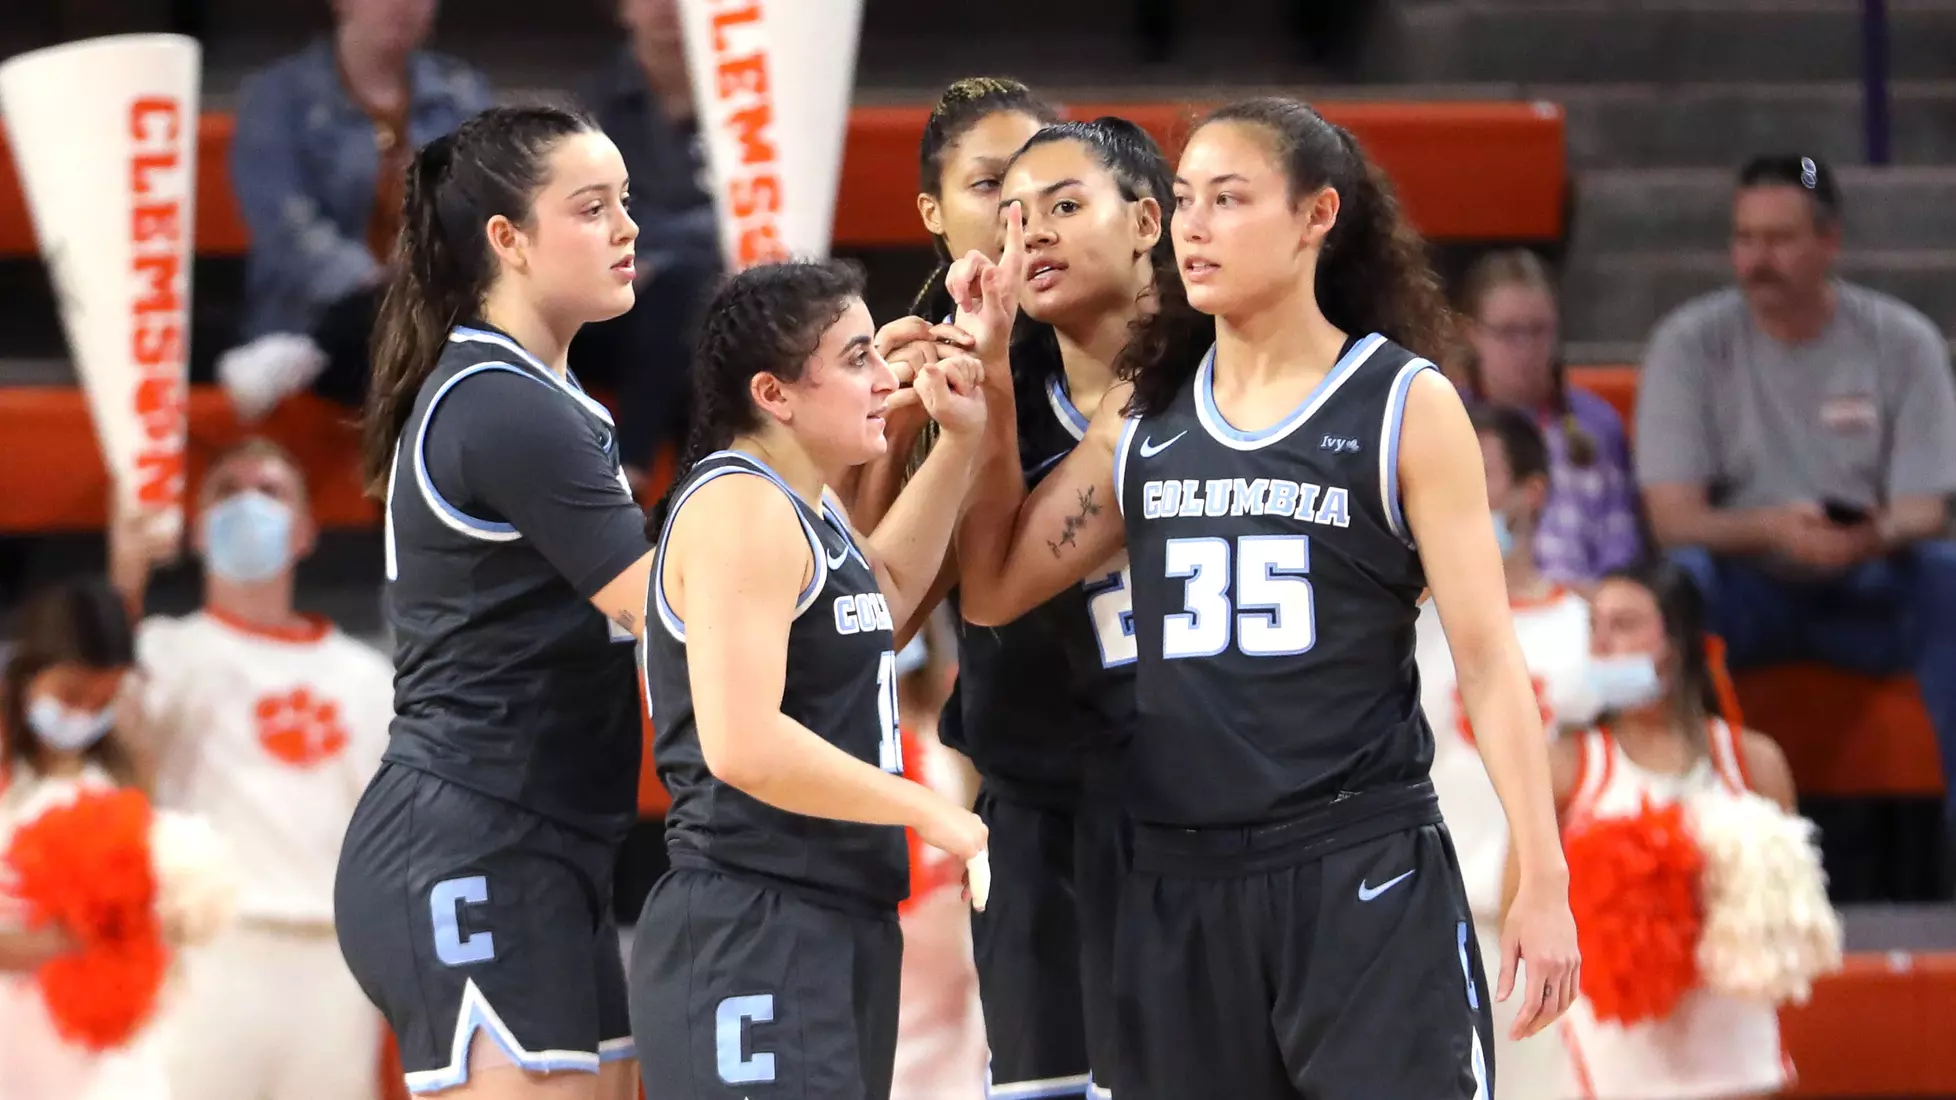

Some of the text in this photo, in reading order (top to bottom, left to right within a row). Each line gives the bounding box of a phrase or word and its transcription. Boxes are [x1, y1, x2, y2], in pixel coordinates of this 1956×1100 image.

[711, 0, 788, 267] LEMSO
[130, 97, 184, 509] CLEMSON
[1320, 435, 1347, 452] Ivy
[1143, 477, 1350, 528] COLUMBIA
[1163, 534, 1317, 660] 35
[430, 875, 495, 966] C
[715, 994, 776, 1084] C
